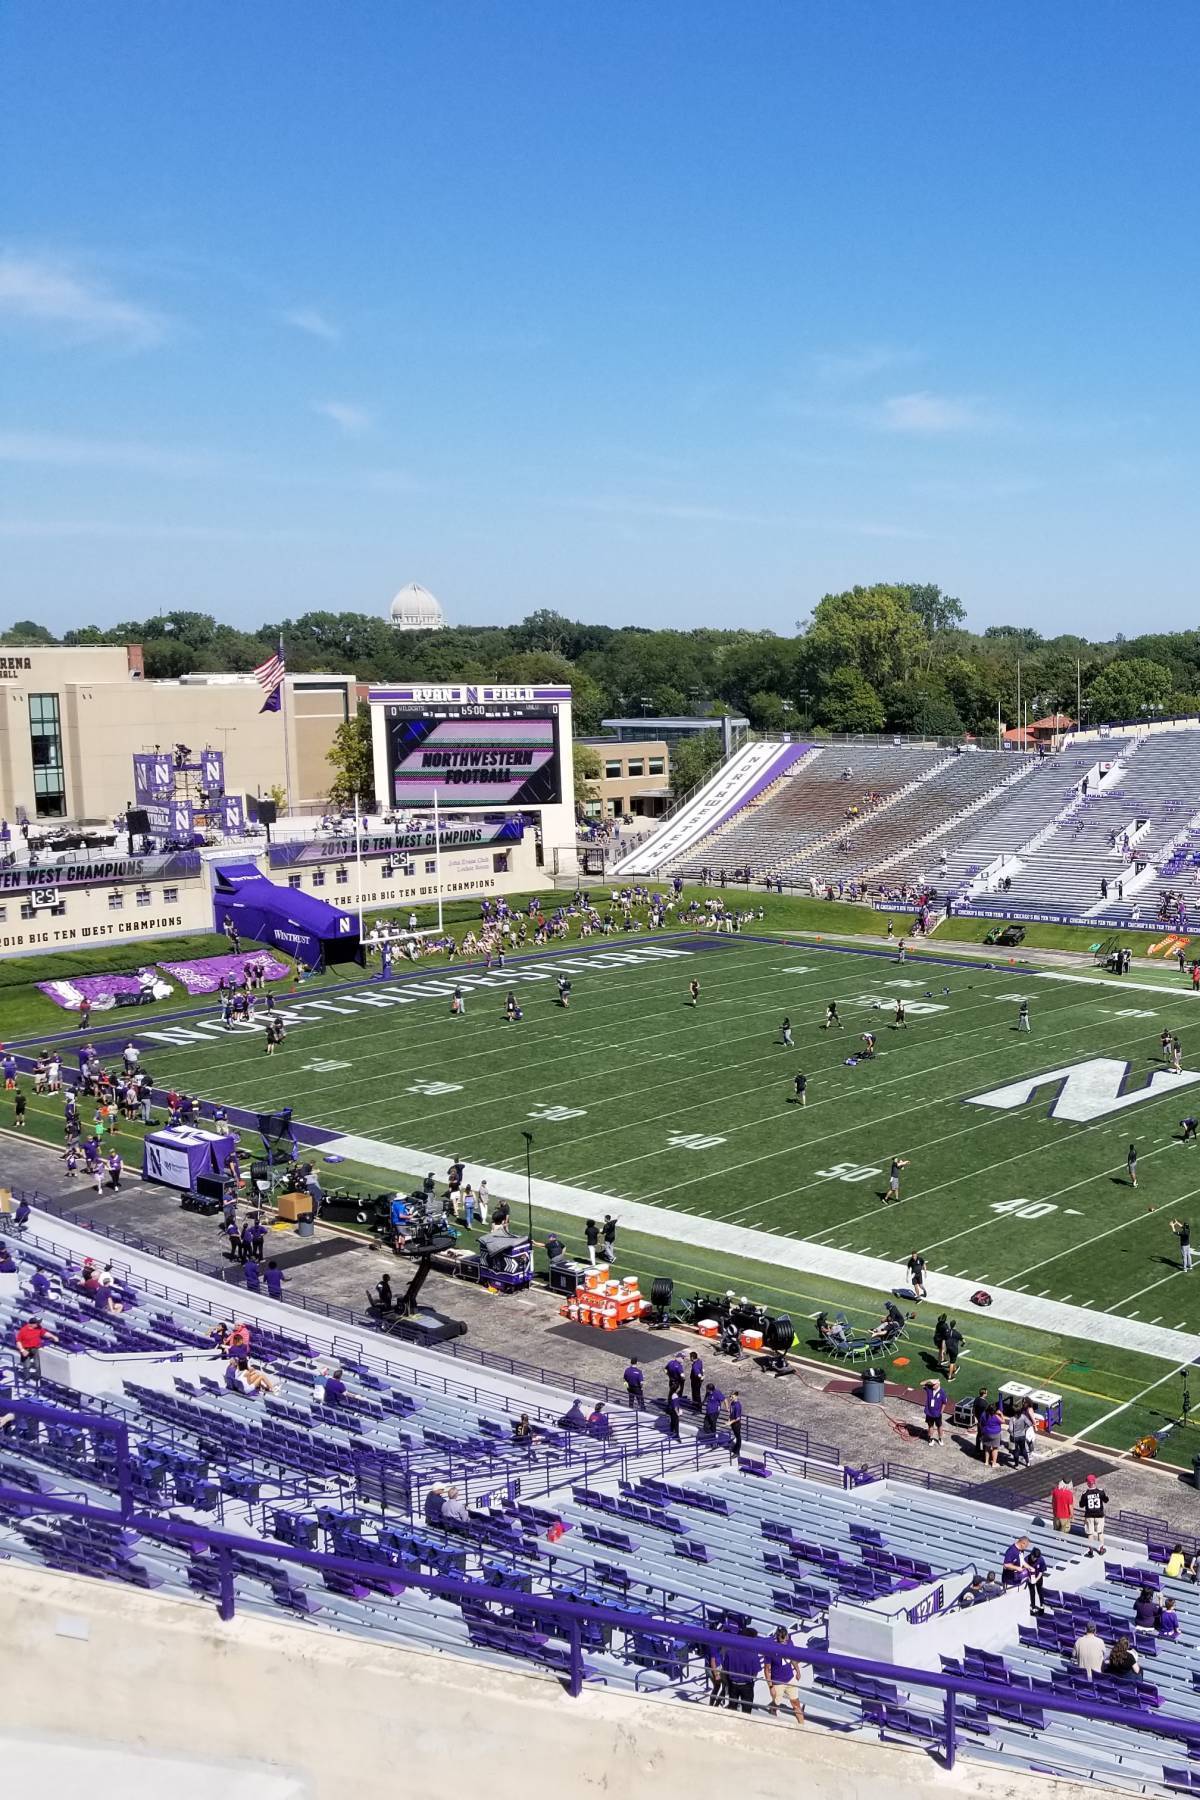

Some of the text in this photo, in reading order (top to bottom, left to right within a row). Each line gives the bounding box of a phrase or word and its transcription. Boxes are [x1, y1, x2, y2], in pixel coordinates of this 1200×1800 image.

[412, 688, 453, 702] RYAN
[466, 687, 479, 704] N
[492, 688, 535, 702] FIELD
[421, 751, 534, 768] NORTHWESTERN
[136, 763, 148, 790] N
[155, 764, 169, 784] N
[206, 762, 220, 781] N
[445, 768, 512, 784] FOOTBALL
[176, 810, 189, 830] N
[226, 807, 239, 827] N
[374, 837, 392, 850] TEN
[395, 834, 422, 848] WEST
[426, 829, 482, 845] CHAMPIONS
[28, 868, 66, 885] WEST
[67, 859, 144, 880] CHAMPIONS
[334, 895, 352, 906] THE
[356, 893, 376, 903] 2018
[381, 890, 395, 900] BIG
[400, 888, 416, 897] TEN
[420, 885, 443, 895] WEST
[447, 879, 495, 893] CHAMPIONS
[0, 916, 183, 947] 2018 BIG TEN WEST CHAMPIONS
[340, 918, 350, 933] N
[274, 930, 311, 945] WINTRUST
[136, 946, 695, 1046] NORTHWESTERN
[405, 1081, 464, 1096] 20
[527, 1105, 587, 1121] 30
[667, 1133, 728, 1150] 40
[149, 1147, 162, 1177] N
[814, 1162, 883, 1182] 50
[989, 1198, 1058, 1220] 40
[1088, 1498, 1100, 1509] 83
[915, 1596, 934, 1623] 127
